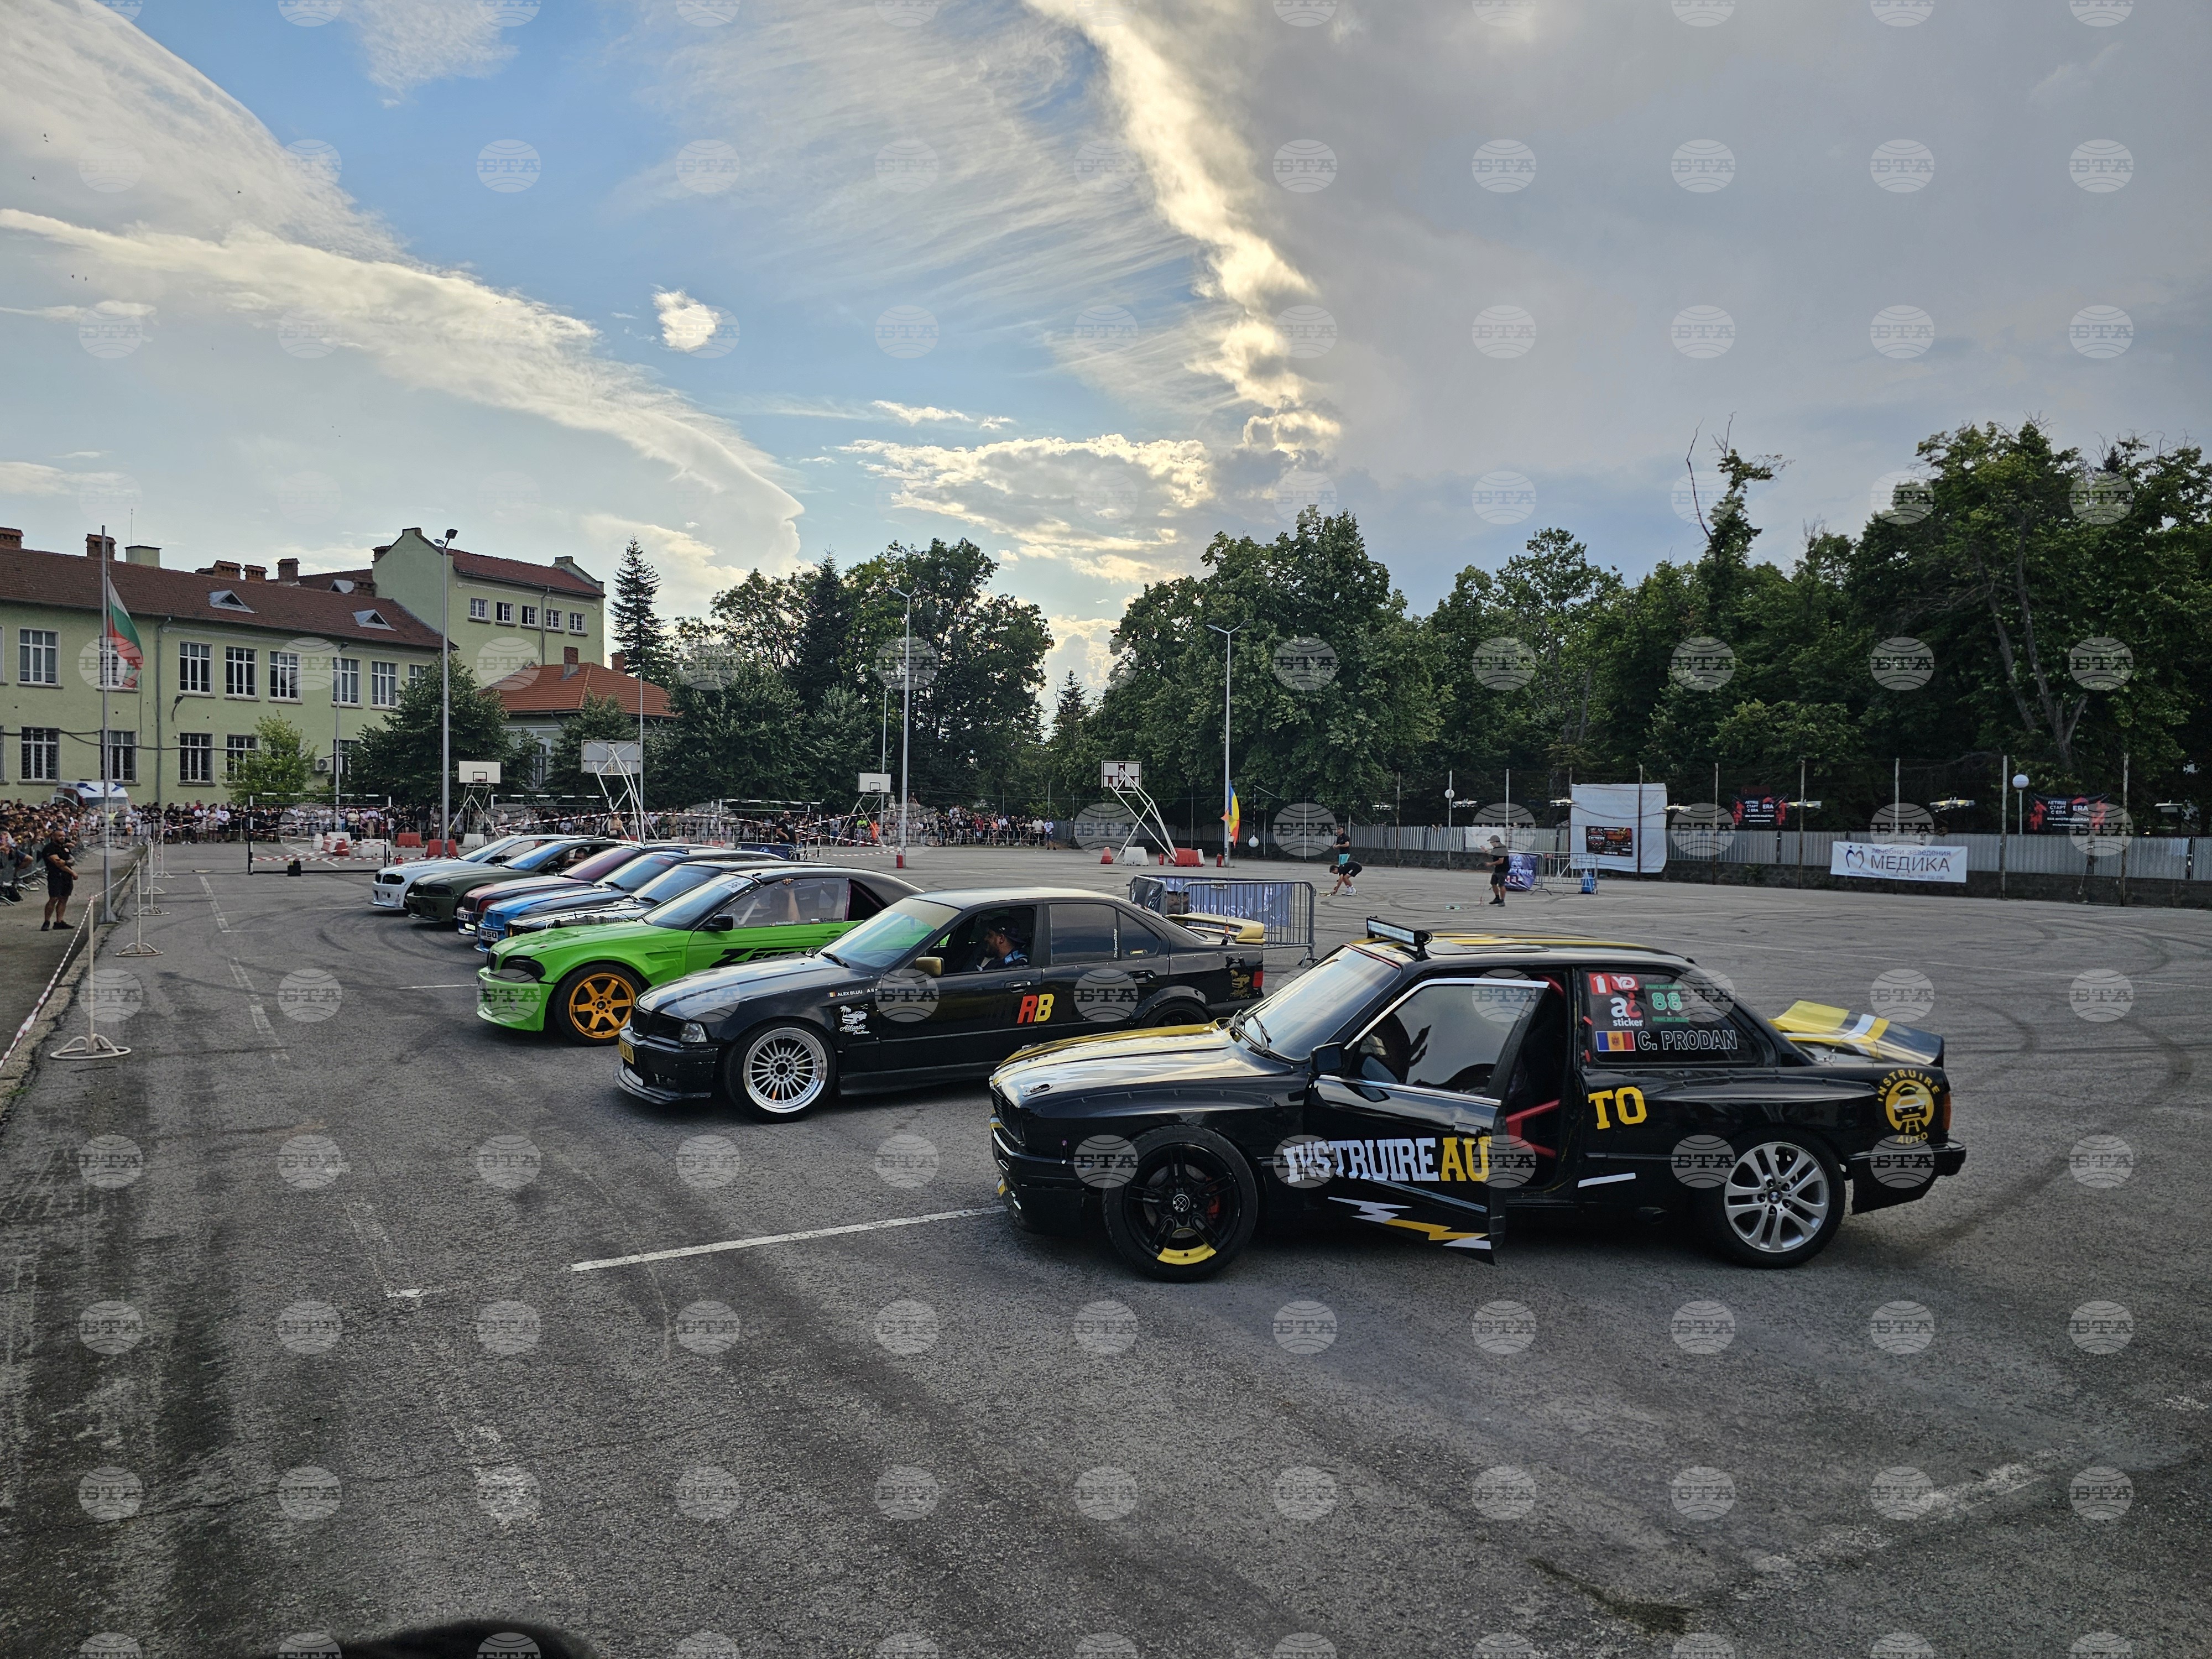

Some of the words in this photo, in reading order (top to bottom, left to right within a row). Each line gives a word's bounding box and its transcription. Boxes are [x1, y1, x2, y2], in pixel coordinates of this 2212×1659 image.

[1871, 855, 1950, 873] МЕДИКА
[1017, 993, 1054, 1024] RB
[1651, 992, 1683, 1011] 88
[839, 1023, 866, 1032] Atlantic
[1613, 1018, 1643, 1026] sticker
[1637, 1030, 1657, 1050] C.
[1661, 1030, 1738, 1050] PRODAN
[1877, 1069, 1940, 1102] INSTRUIRE
[1588, 1087, 1647, 1130] TO
[1896, 1131, 1928, 1144] AUTO
